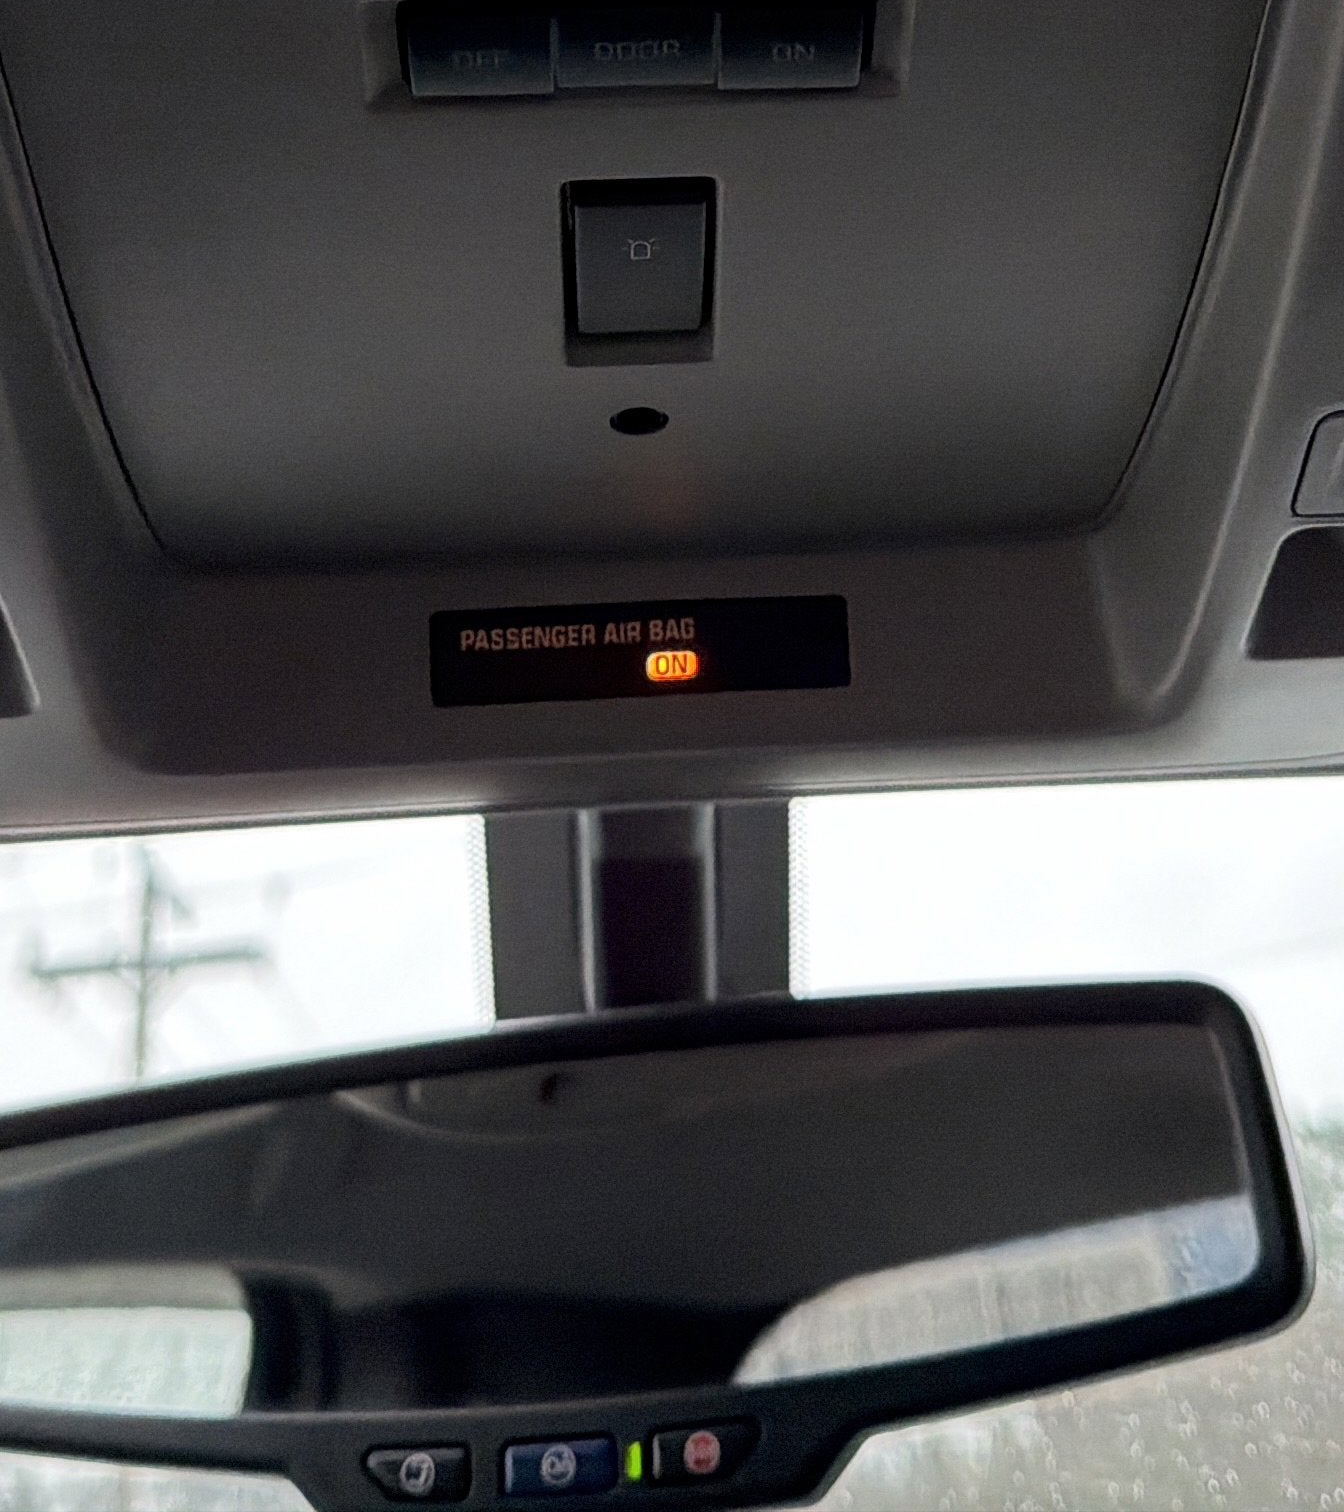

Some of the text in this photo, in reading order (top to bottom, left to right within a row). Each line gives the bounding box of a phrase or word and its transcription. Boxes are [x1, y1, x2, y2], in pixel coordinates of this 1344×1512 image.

[452, 48, 510, 68] OFF
[594, 39, 680, 62] DOOR
[772, 43, 815, 63] ON
[460, 617, 696, 651] PASSENGER AIR BAG
[654, 653, 689, 677] ON
